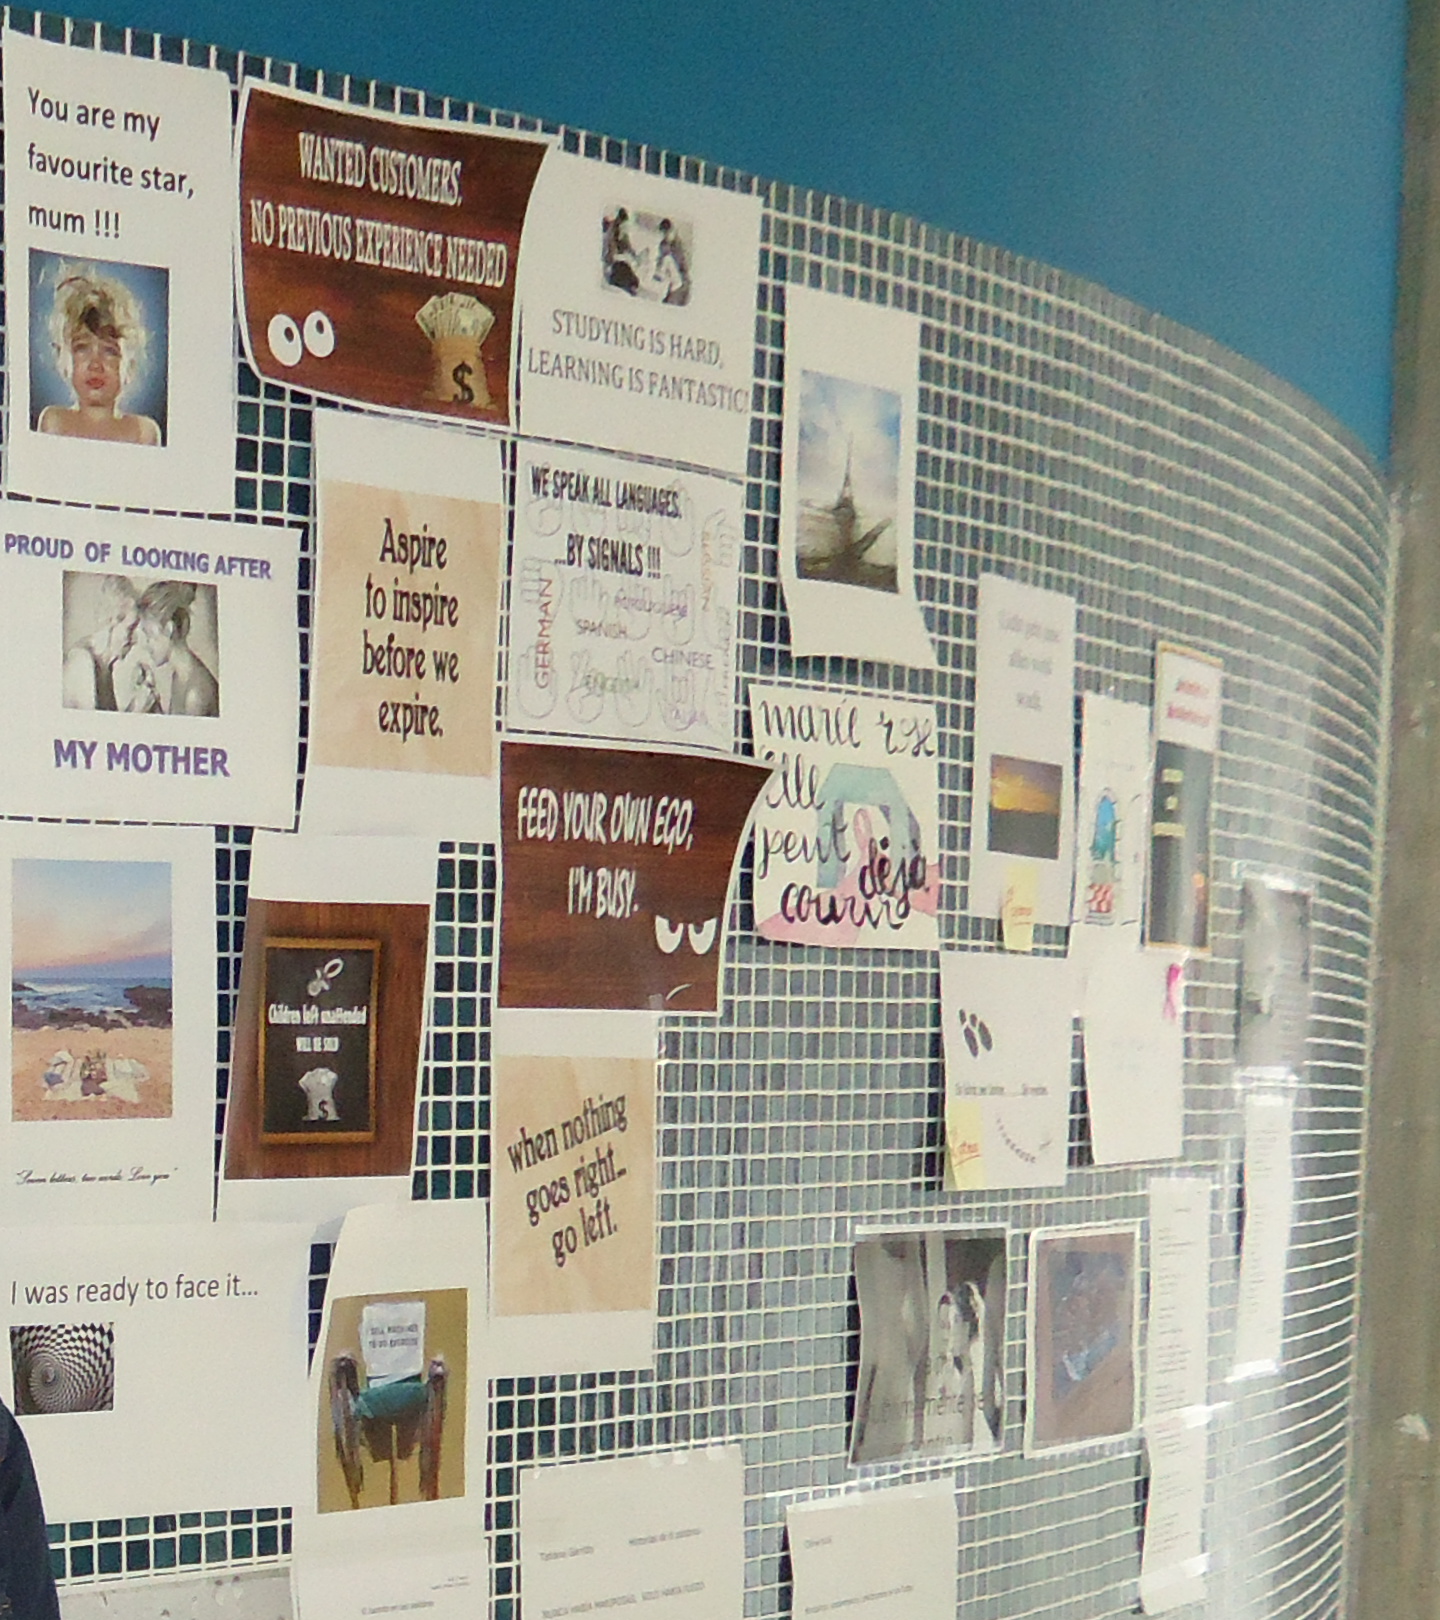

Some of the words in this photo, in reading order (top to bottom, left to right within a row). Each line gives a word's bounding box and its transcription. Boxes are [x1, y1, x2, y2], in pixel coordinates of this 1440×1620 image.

[27, 87, 68, 124] You
[75, 103, 116, 131] are
[123, 111, 160, 142] my
[27, 142, 134, 188] favourite
[140, 161, 196, 199] star,
[298, 131, 366, 188] WANTED
[28, 204, 85, 236] mum
[249, 199, 274, 248] NO
[277, 202, 353, 262] PREVIOUS
[355, 217, 444, 279] EXPERIENCE
[446, 235, 508, 289] NEEDED
[552, 308, 645, 352] STUDYING
[649, 329, 665, 356] IS
[527, 347, 623, 390] LEARNING
[628, 367, 644, 393] IS
[530, 465, 550, 497] WE
[552, 469, 591, 501] SPEAK
[593, 475, 612, 508] ALL
[4, 533, 74, 559] PROUD
[84, 541, 111, 563] OF
[121, 544, 210, 574] LOOKING
[213, 554, 272, 580] AFTER
[378, 516, 448, 575] Aspire
[587, 536, 643, 577] SIGNALS
[364, 572, 387, 619] to
[392, 576, 460, 633] inspire
[361, 629, 426, 681] before
[432, 649, 460, 684] we
[533, 577, 554, 690] GERMAN
[651, 646, 716, 671] CHINESE
[378, 691, 444, 743] expire.
[53, 739, 98, 770] MY
[106, 741, 231, 778] MOTHER
[517, 785, 559, 841] FEED
[562, 791, 606, 845] YOUR
[610, 792, 653, 846] OWN
[568, 866, 593, 915] I'M
[595, 867, 639, 919] BUSY.
[269, 1003, 301, 1024] Children
[507, 1126, 559, 1173] when
[561, 1094, 628, 1151] nothing
[526, 1175, 571, 1227] goes
[552, 1225, 578, 1268] go
[579, 1196, 618, 1247] left.
[10, 1279, 18, 1306] I
[25, 1284, 68, 1305] was
[76, 1276, 139, 1307] ready
[145, 1278, 168, 1300] to
[175, 1273, 220, 1300] face
[225, 1272, 259, 1299] it...
